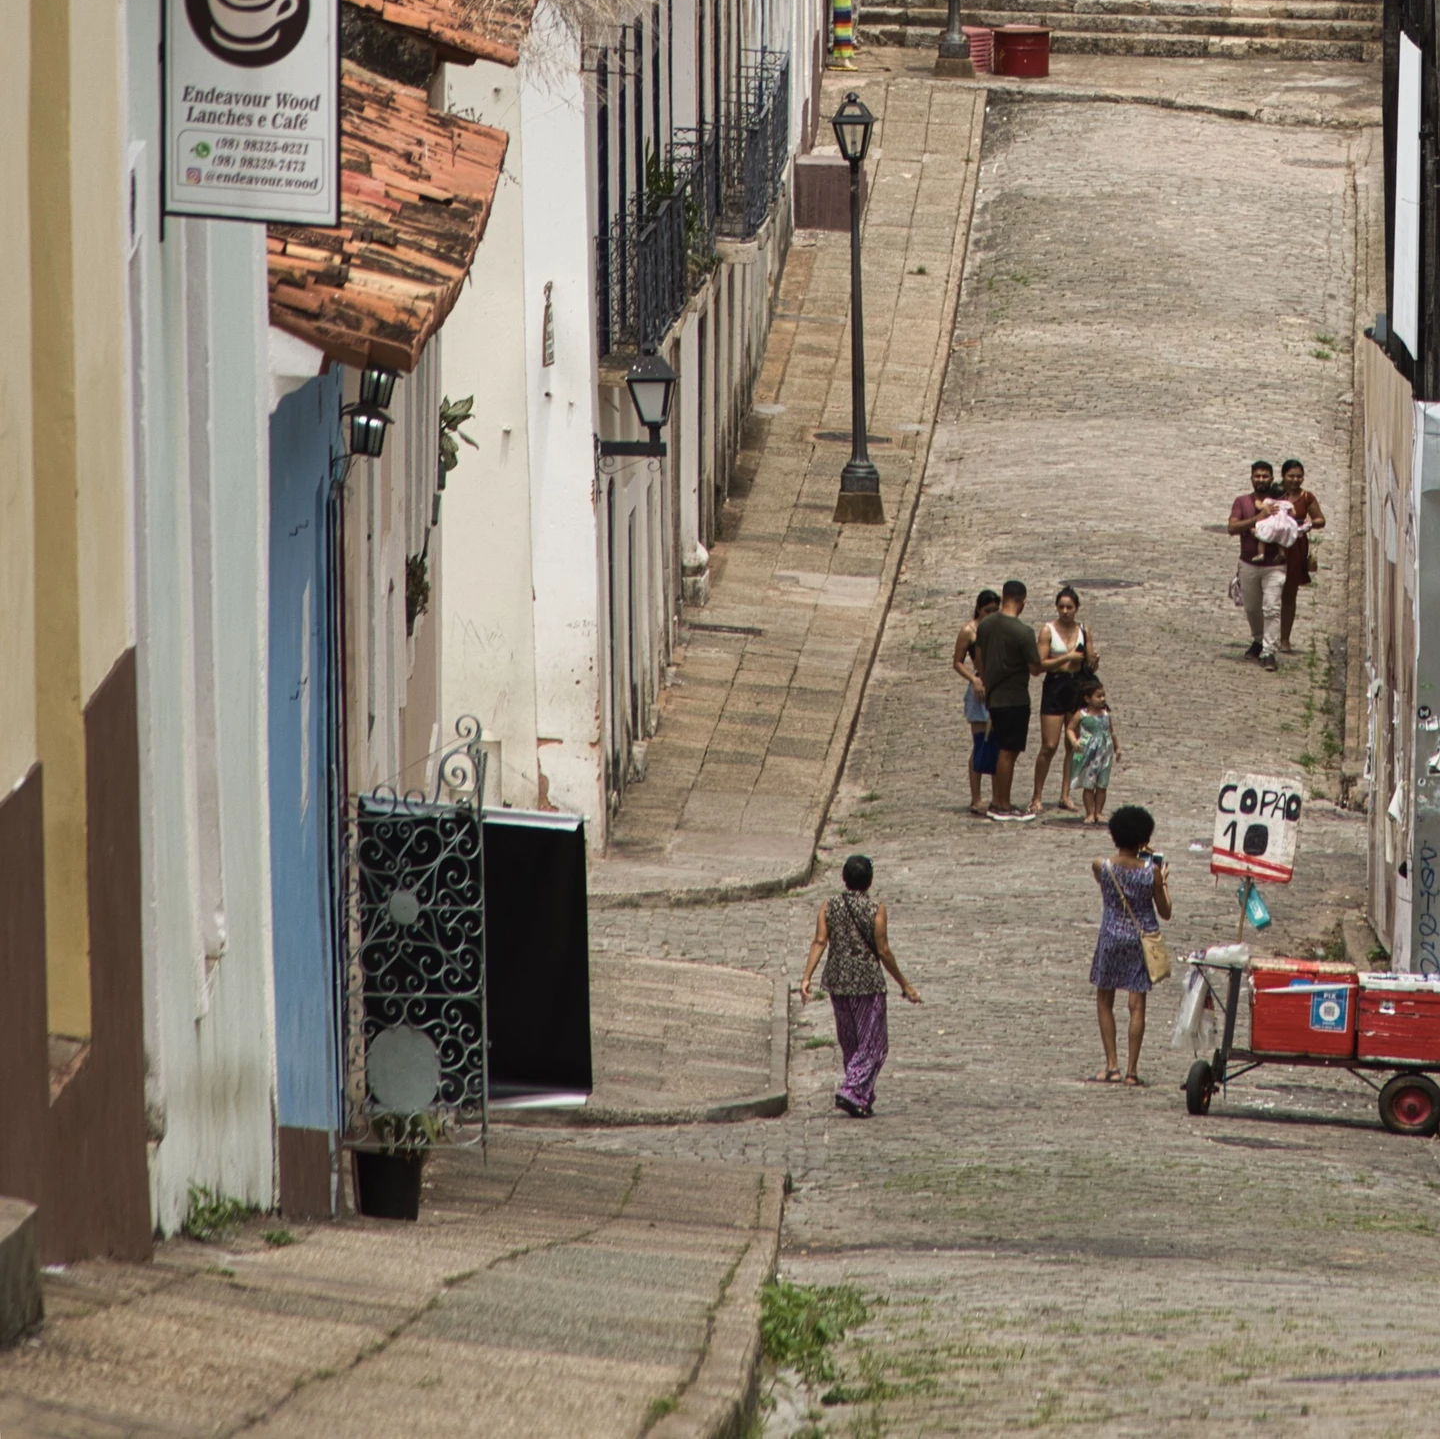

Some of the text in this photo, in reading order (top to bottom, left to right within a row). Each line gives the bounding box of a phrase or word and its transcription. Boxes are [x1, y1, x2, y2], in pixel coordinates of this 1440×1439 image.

[182, 85, 321, 112] Endeavour Wood
[185, 106, 309, 131] Lanches e Café
[215, 137, 240, 151] (98)
[212, 154, 236, 168] (98)
[204, 171, 319, 190] @endeavour.wood
[1218, 783, 1302, 821] COPÃO
[1222, 820, 1269, 856] 10
[1323, 992, 1337, 1000] PIX
